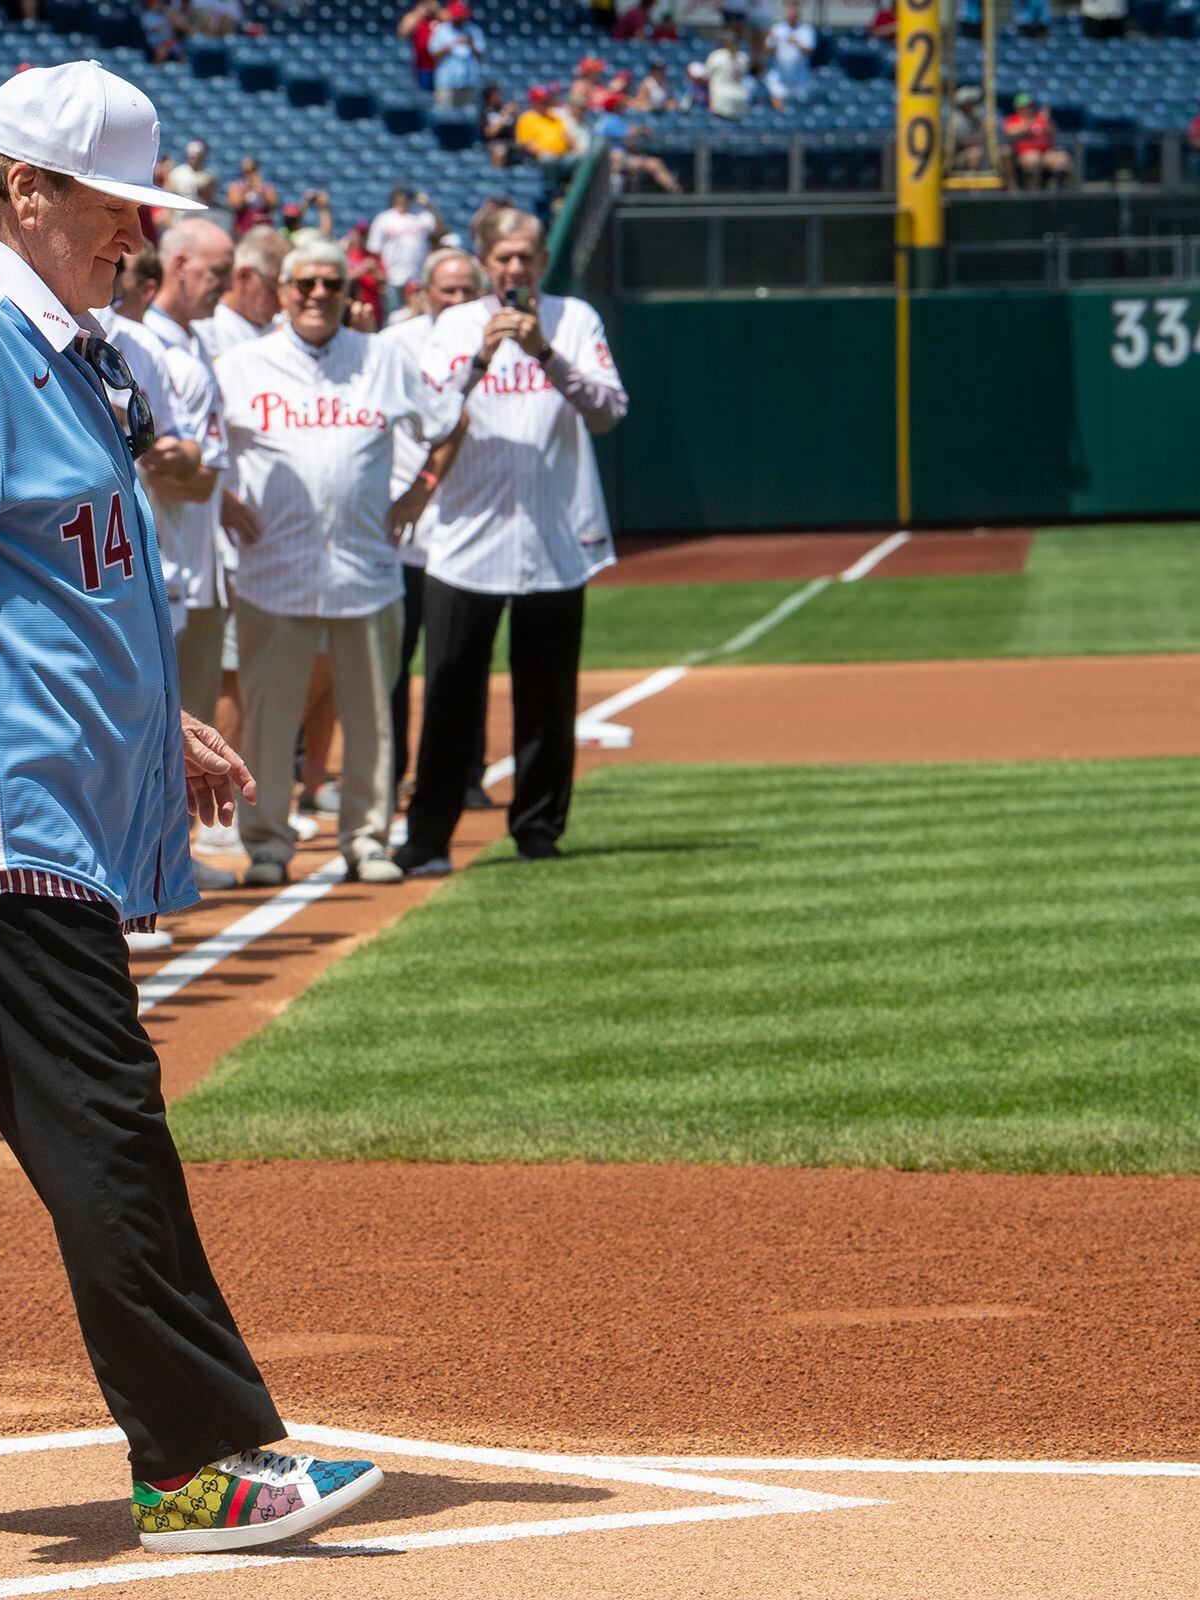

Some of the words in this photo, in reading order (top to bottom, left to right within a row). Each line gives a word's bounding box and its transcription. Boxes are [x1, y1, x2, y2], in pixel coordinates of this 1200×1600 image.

[907, 0, 935, 182] 29
[1111, 298, 1200, 369] 33
[251, 392, 387, 432] Phillies
[59, 490, 134, 593] 14
